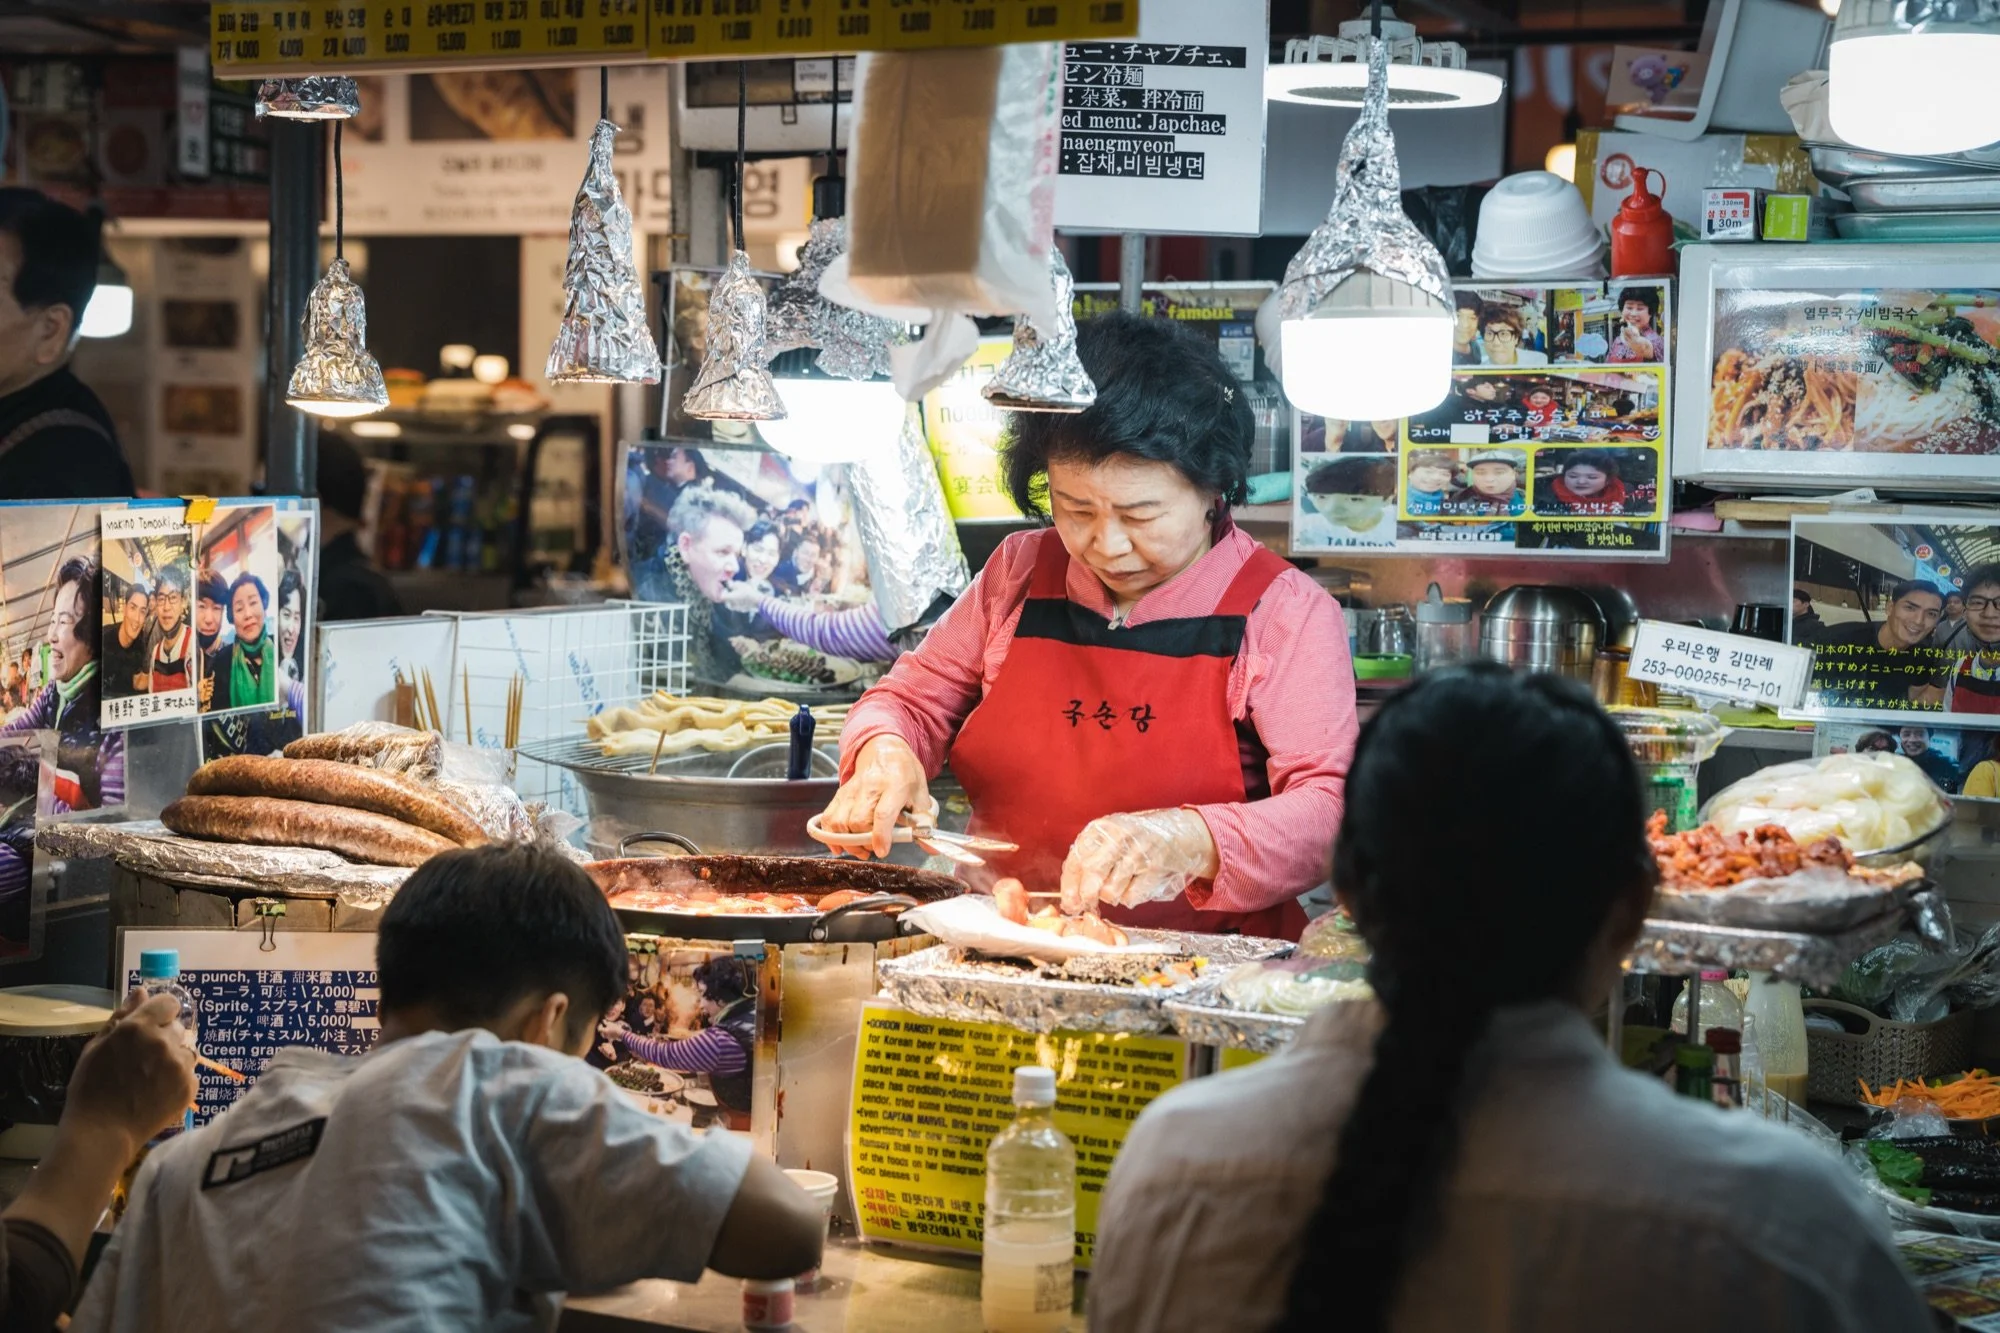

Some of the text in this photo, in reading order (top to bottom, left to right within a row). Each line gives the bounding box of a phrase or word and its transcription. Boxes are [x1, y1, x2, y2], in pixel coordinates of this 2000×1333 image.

[1089, 113, 1142, 129] menu:
[1148, 113, 1226, 134] Japchae,
[1062, 137, 1175, 154] naengmyeon
[1718, 219, 1742, 228] 30m
[1168, 303, 1235, 320] famous
[1661, 638, 1721, 664] 우리은행
[1641, 658, 1783, 698] 253-000255-12-101
[201, 971, 250, 985] punch,
[312, 985, 355, 999] 2,000)
[199, 1000, 253, 1014] (Sprite,
[308, 1014, 351, 1028] 5,000)
